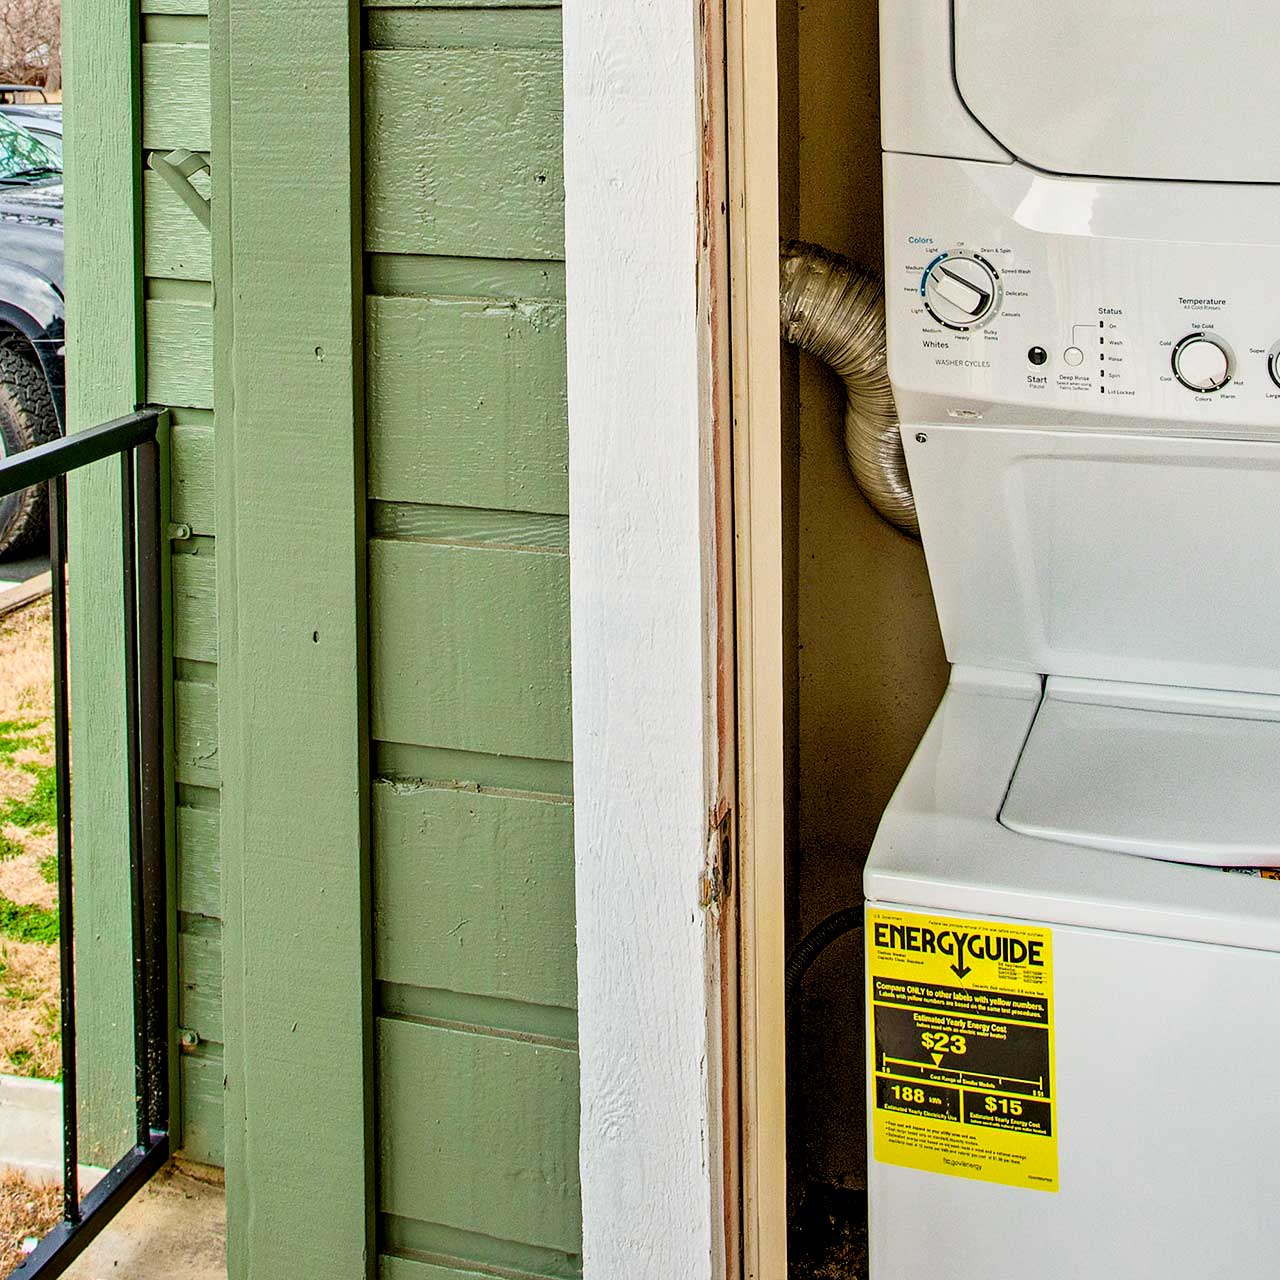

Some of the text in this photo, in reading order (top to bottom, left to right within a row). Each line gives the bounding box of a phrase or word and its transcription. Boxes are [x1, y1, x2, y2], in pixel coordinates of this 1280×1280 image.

[908, 236, 934, 244] Colors
[1178, 297, 1227, 307] Temperature
[922, 341, 949, 349] Whites
[935, 359, 991, 368] WASHER CYCLES
[1027, 375, 1048, 384] Start
[874, 922, 1044, 967] ENERGYGUIDE
[876, 981, 1044, 1011] Compare ONLY to other labels with yellow numbers.
[879, 990, 895, 998] Labels
[923, 997, 945, 1006] numbers
[954, 1001, 970, 1009] based
[913, 1013, 946, 1025] Estimated
[946, 1017, 966, 1028] Yearly
[967, 1020, 990, 1032] Energy
[991, 1024, 1007, 1033] Cost
[921, 1032, 967, 1055] $23
[941, 1075, 956, 1084] Range
[978, 1081, 996, 1089] Models
[891, 1085, 942, 1105] 188 kWh
[884, 1103, 907, 1113] Estimated
[908, 1108, 923, 1116] Yearly
[923, 1110, 947, 1120] Electricity
[984, 1096, 1023, 1116] $15
[969, 1112, 994, 1121] Estimated
[994, 1116, 1010, 1125] Yearly
[1011, 1119, 1028, 1127] Energy
